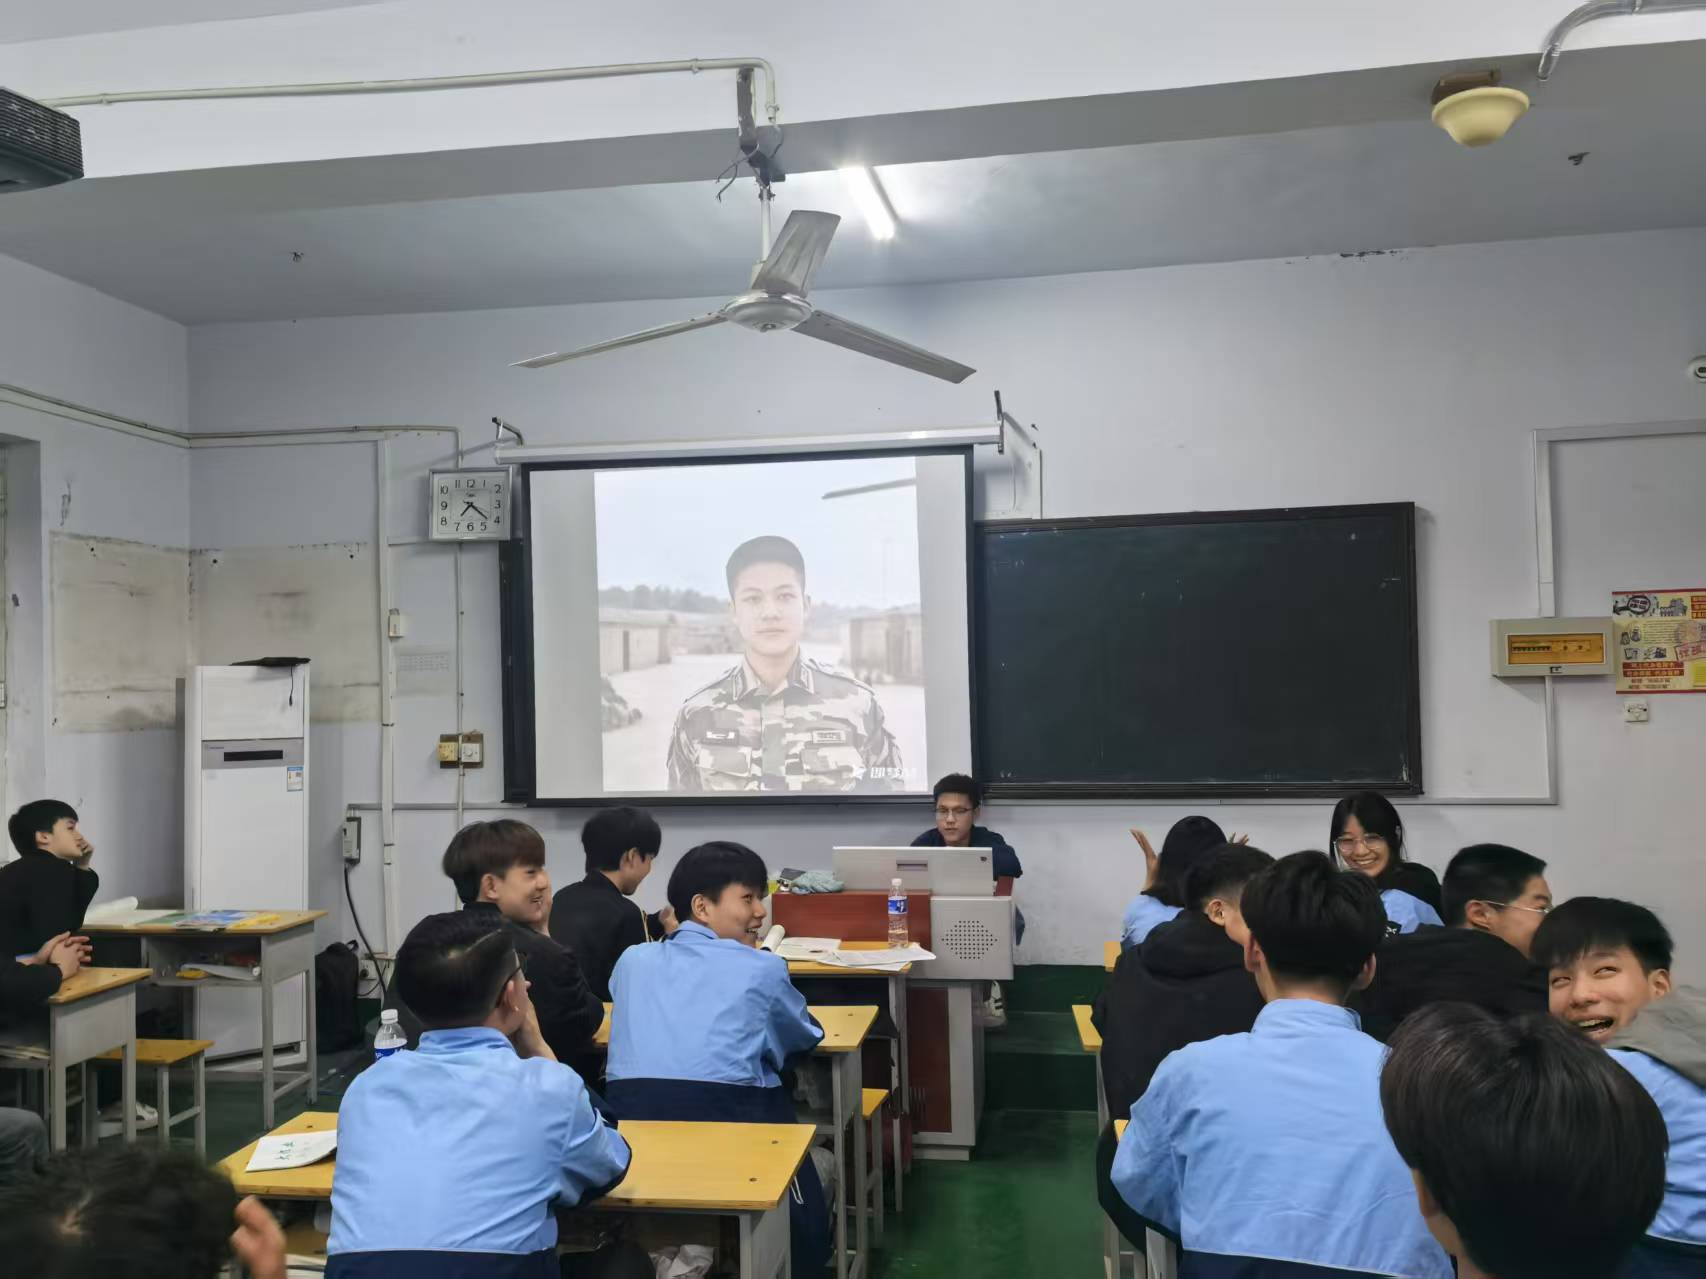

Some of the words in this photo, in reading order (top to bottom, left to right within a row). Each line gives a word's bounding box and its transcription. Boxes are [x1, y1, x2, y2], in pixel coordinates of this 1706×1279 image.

[455, 480, 460, 488] 11
[467, 479, 475, 488] 12
[440, 485, 449, 495] 10
[494, 484, 502, 494] 2
[440, 501, 448, 511] 9
[494, 500, 501, 509] 3
[440, 516, 448, 526] 8
[494, 515, 500, 524] 4
[454, 522, 460, 532] 7
[467, 522, 474, 532] 6
[480, 521, 487, 532] 5
